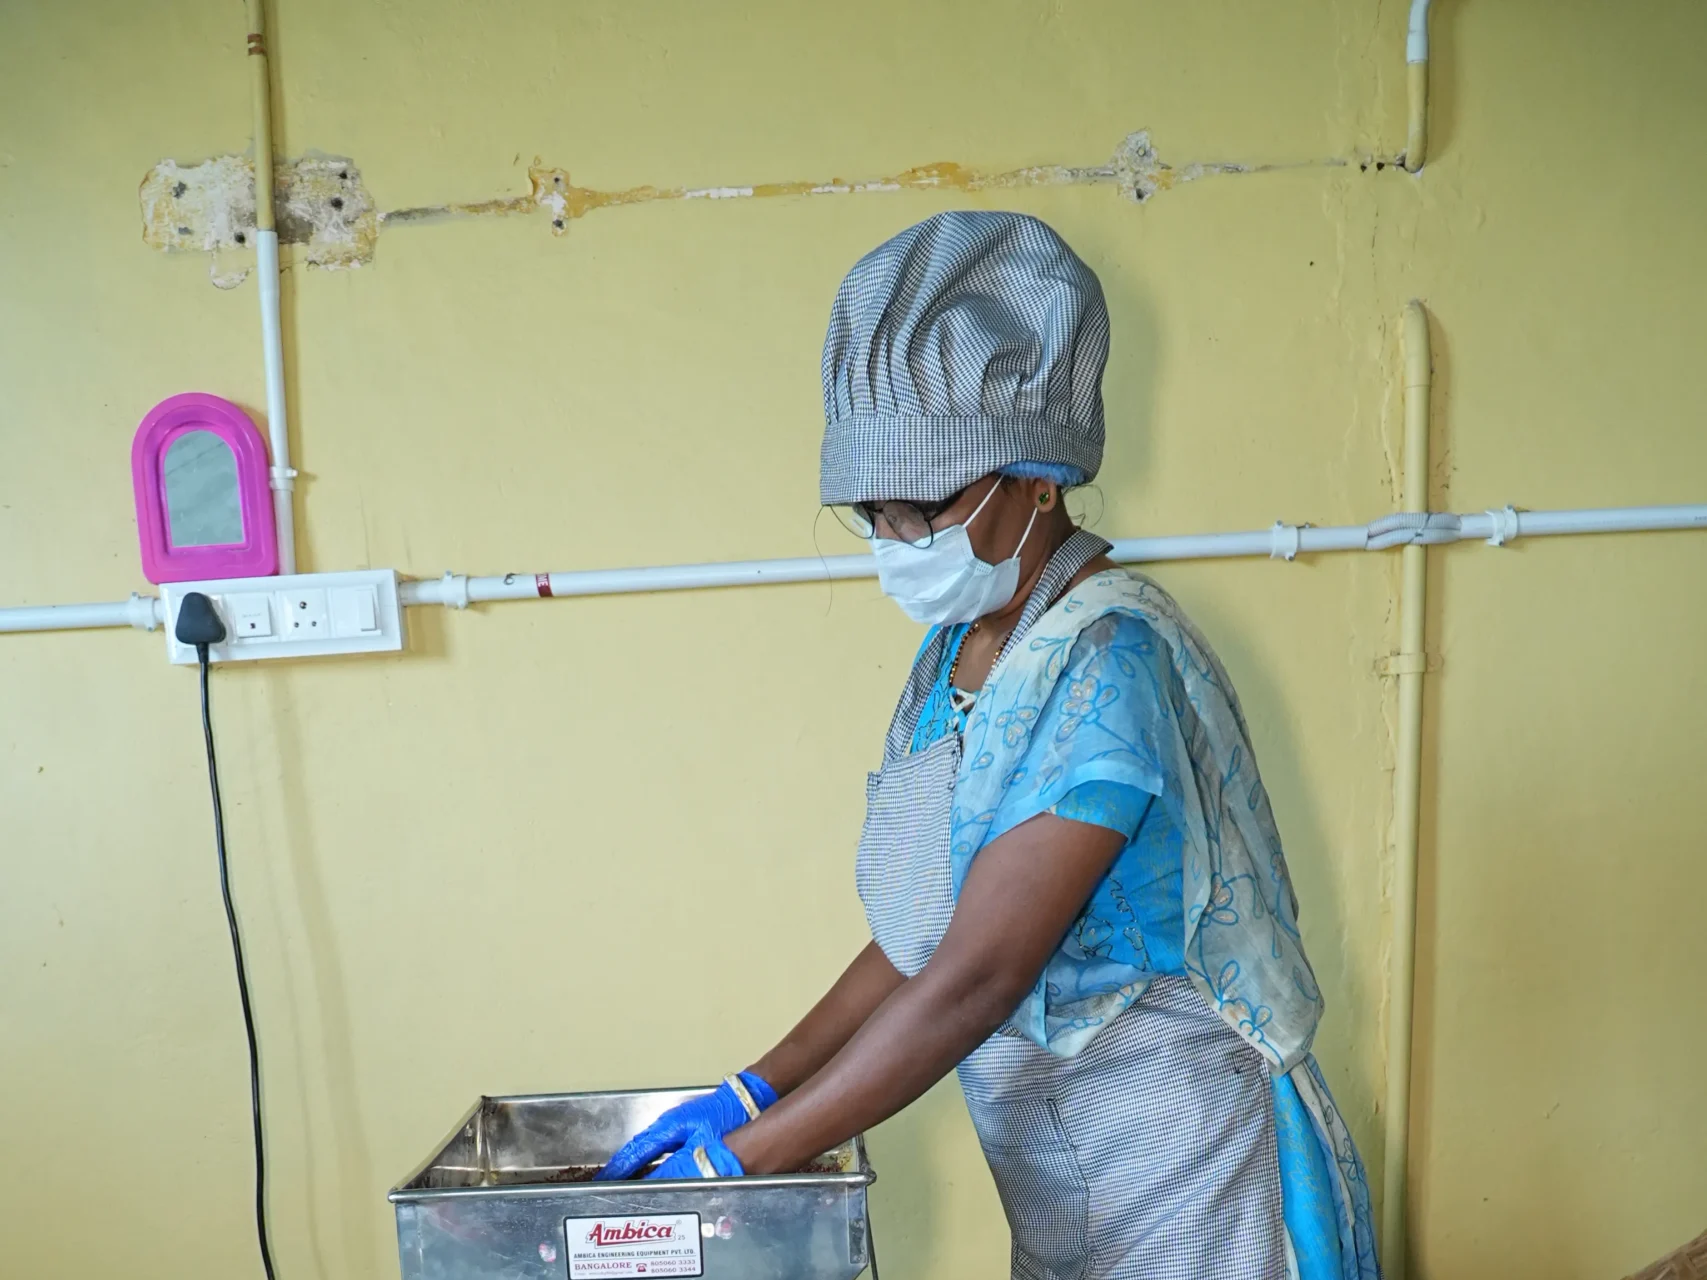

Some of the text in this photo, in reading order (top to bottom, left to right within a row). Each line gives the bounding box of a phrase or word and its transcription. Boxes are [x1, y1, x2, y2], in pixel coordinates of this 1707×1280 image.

[587, 1221, 674, 1247] Ambica
[598, 1250, 635, 1258] ENGINEERING
[574, 1262, 632, 1271] BANGALORE
